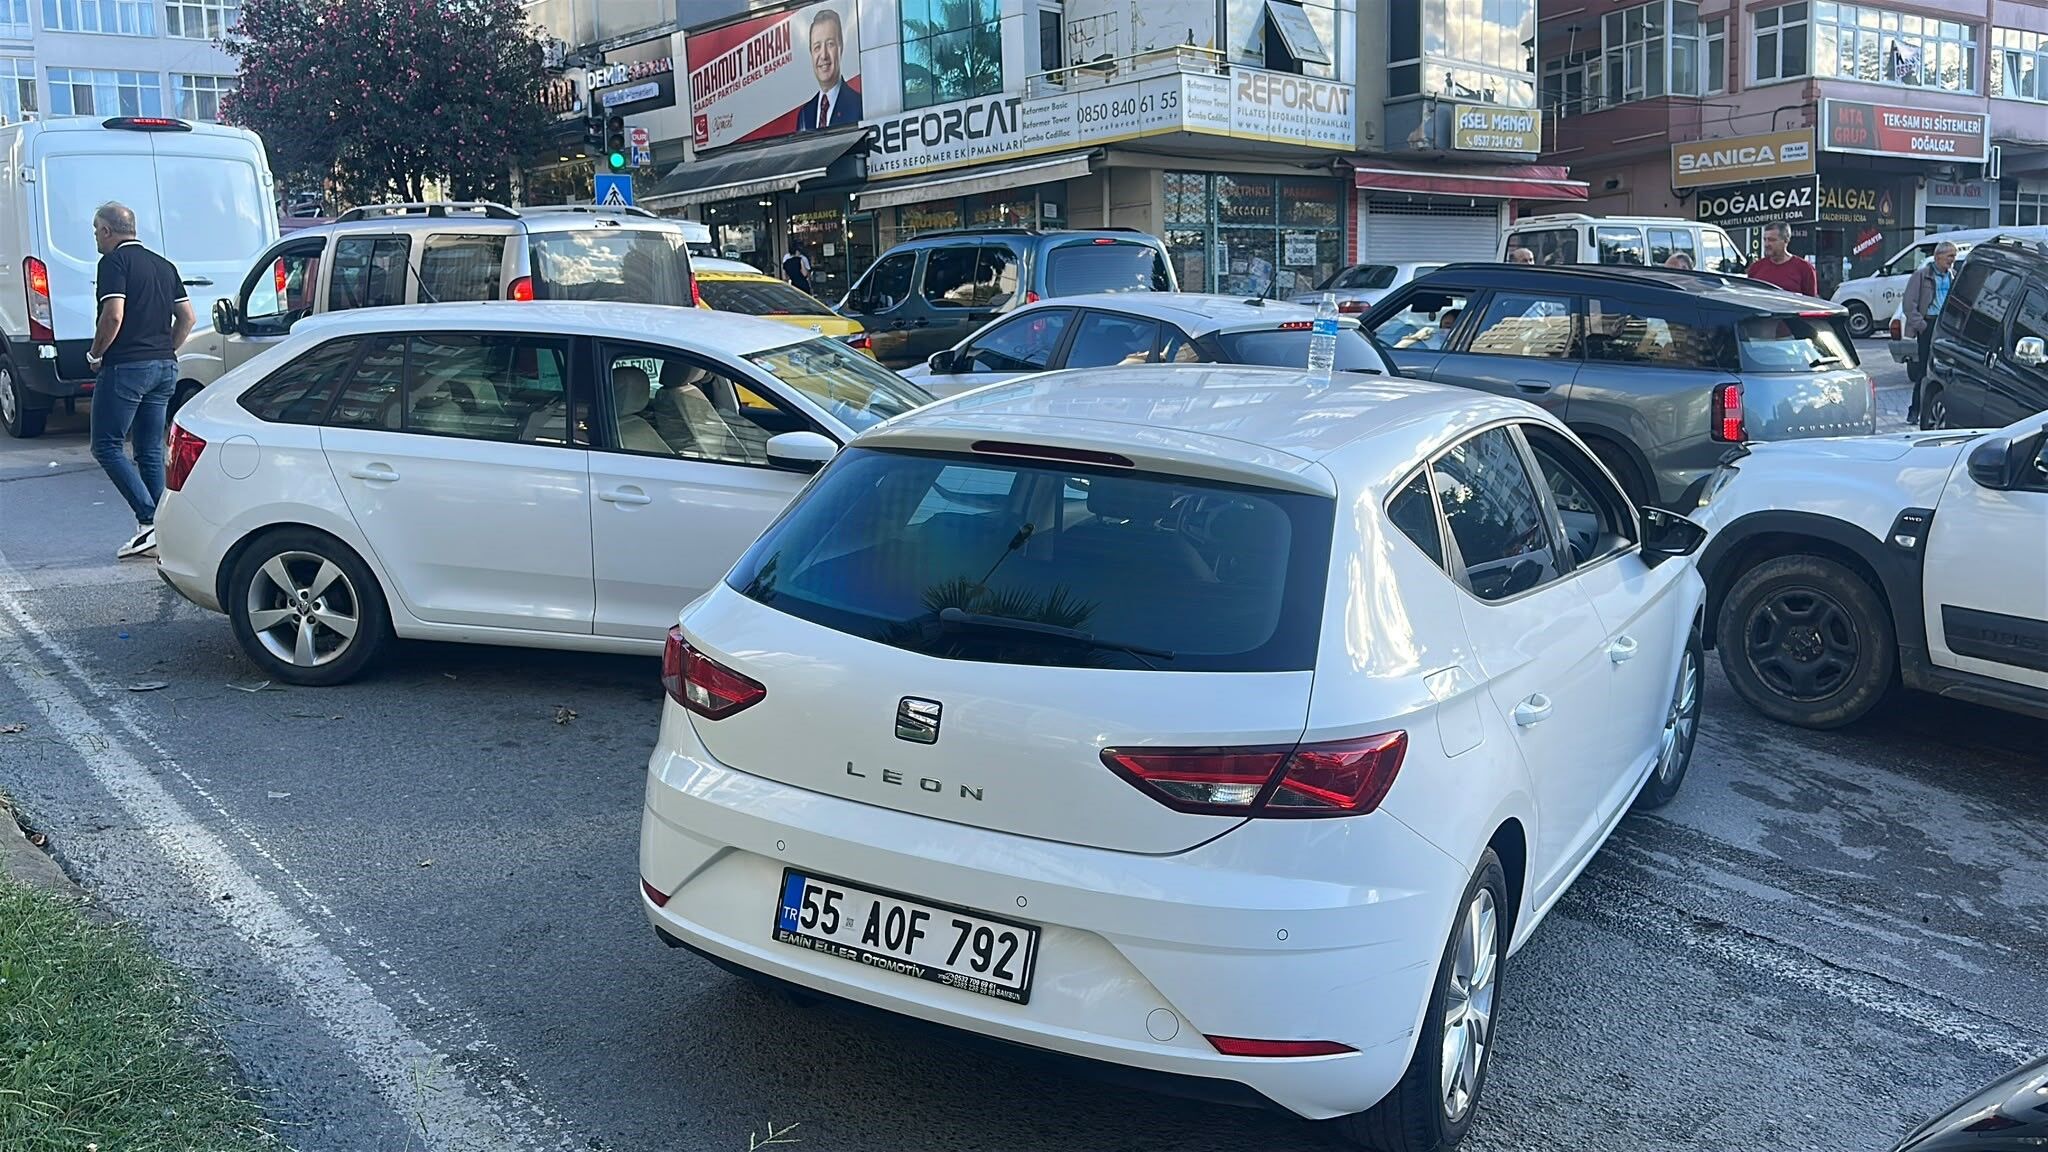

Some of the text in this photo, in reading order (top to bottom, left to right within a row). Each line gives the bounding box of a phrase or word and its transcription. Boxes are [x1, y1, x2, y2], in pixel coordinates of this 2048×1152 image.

[692, 21, 791, 103] MAHMUT ARIKAN
[587, 61, 629, 90] DEMİR
[693, 94, 717, 113] SAADET
[742, 71, 763, 87] GENEL
[764, 53, 793, 76] BAŞKANI
[1237, 72, 1350, 115] REFORCAT
[1022, 101, 1068, 115] Reformer Basic
[1077, 90, 1178, 124] 0850 840 61 55
[1839, 107, 1864, 125] MTA
[866, 97, 1022, 156] REFORCAT
[1023, 116, 1071, 130] Reformer Tower
[1460, 113, 1534, 132] ASEL MANAV
[1883, 113, 1981, 133] TEK-SAM ISI SİSTEMLERİ
[1023, 133, 1044, 143] Combo
[1834, 126, 1867, 144] GRUP
[1911, 135, 1955, 152] DOĞALGAZ
[902, 152, 951, 167] REFORMER
[1678, 145, 1776, 170] SANICA
[1700, 187, 1811, 217] DOĞALGAZ
[1853, 232, 1883, 256] KAMPANYA
[846, 761, 984, 801] LEON
[783, 906, 798, 921] TR
[800, 884, 1019, 981] 55 AOF 792
[779, 930, 812, 949] EMİN
[815, 941, 858, 961] ELLER
[862, 953, 926, 979] OTOMOTİV
